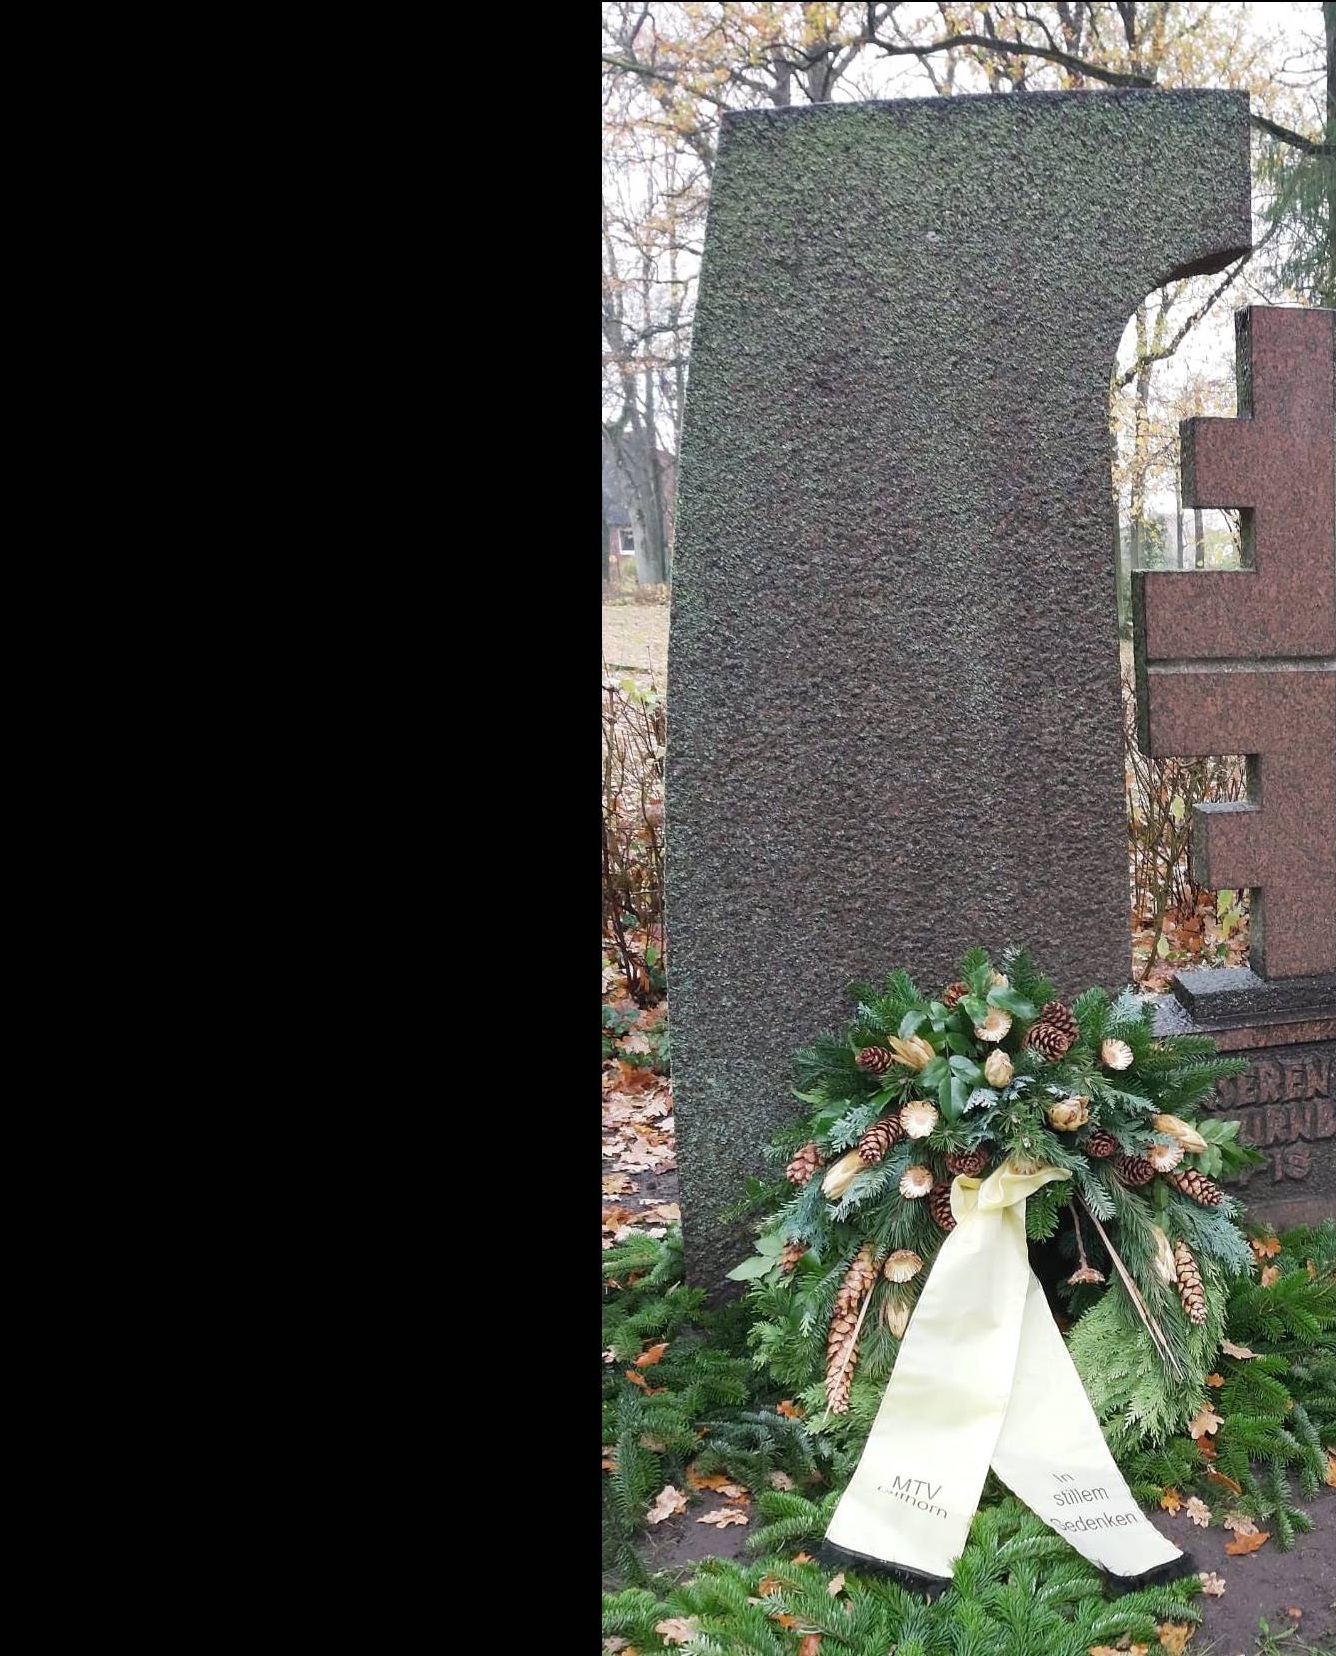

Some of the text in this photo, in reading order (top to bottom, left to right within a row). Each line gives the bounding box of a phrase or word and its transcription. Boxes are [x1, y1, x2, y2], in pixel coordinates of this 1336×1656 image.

[892, 1475, 943, 1501] MTV
[1051, 1472, 1076, 1484] In
[1053, 1486, 1109, 1507] stillem
